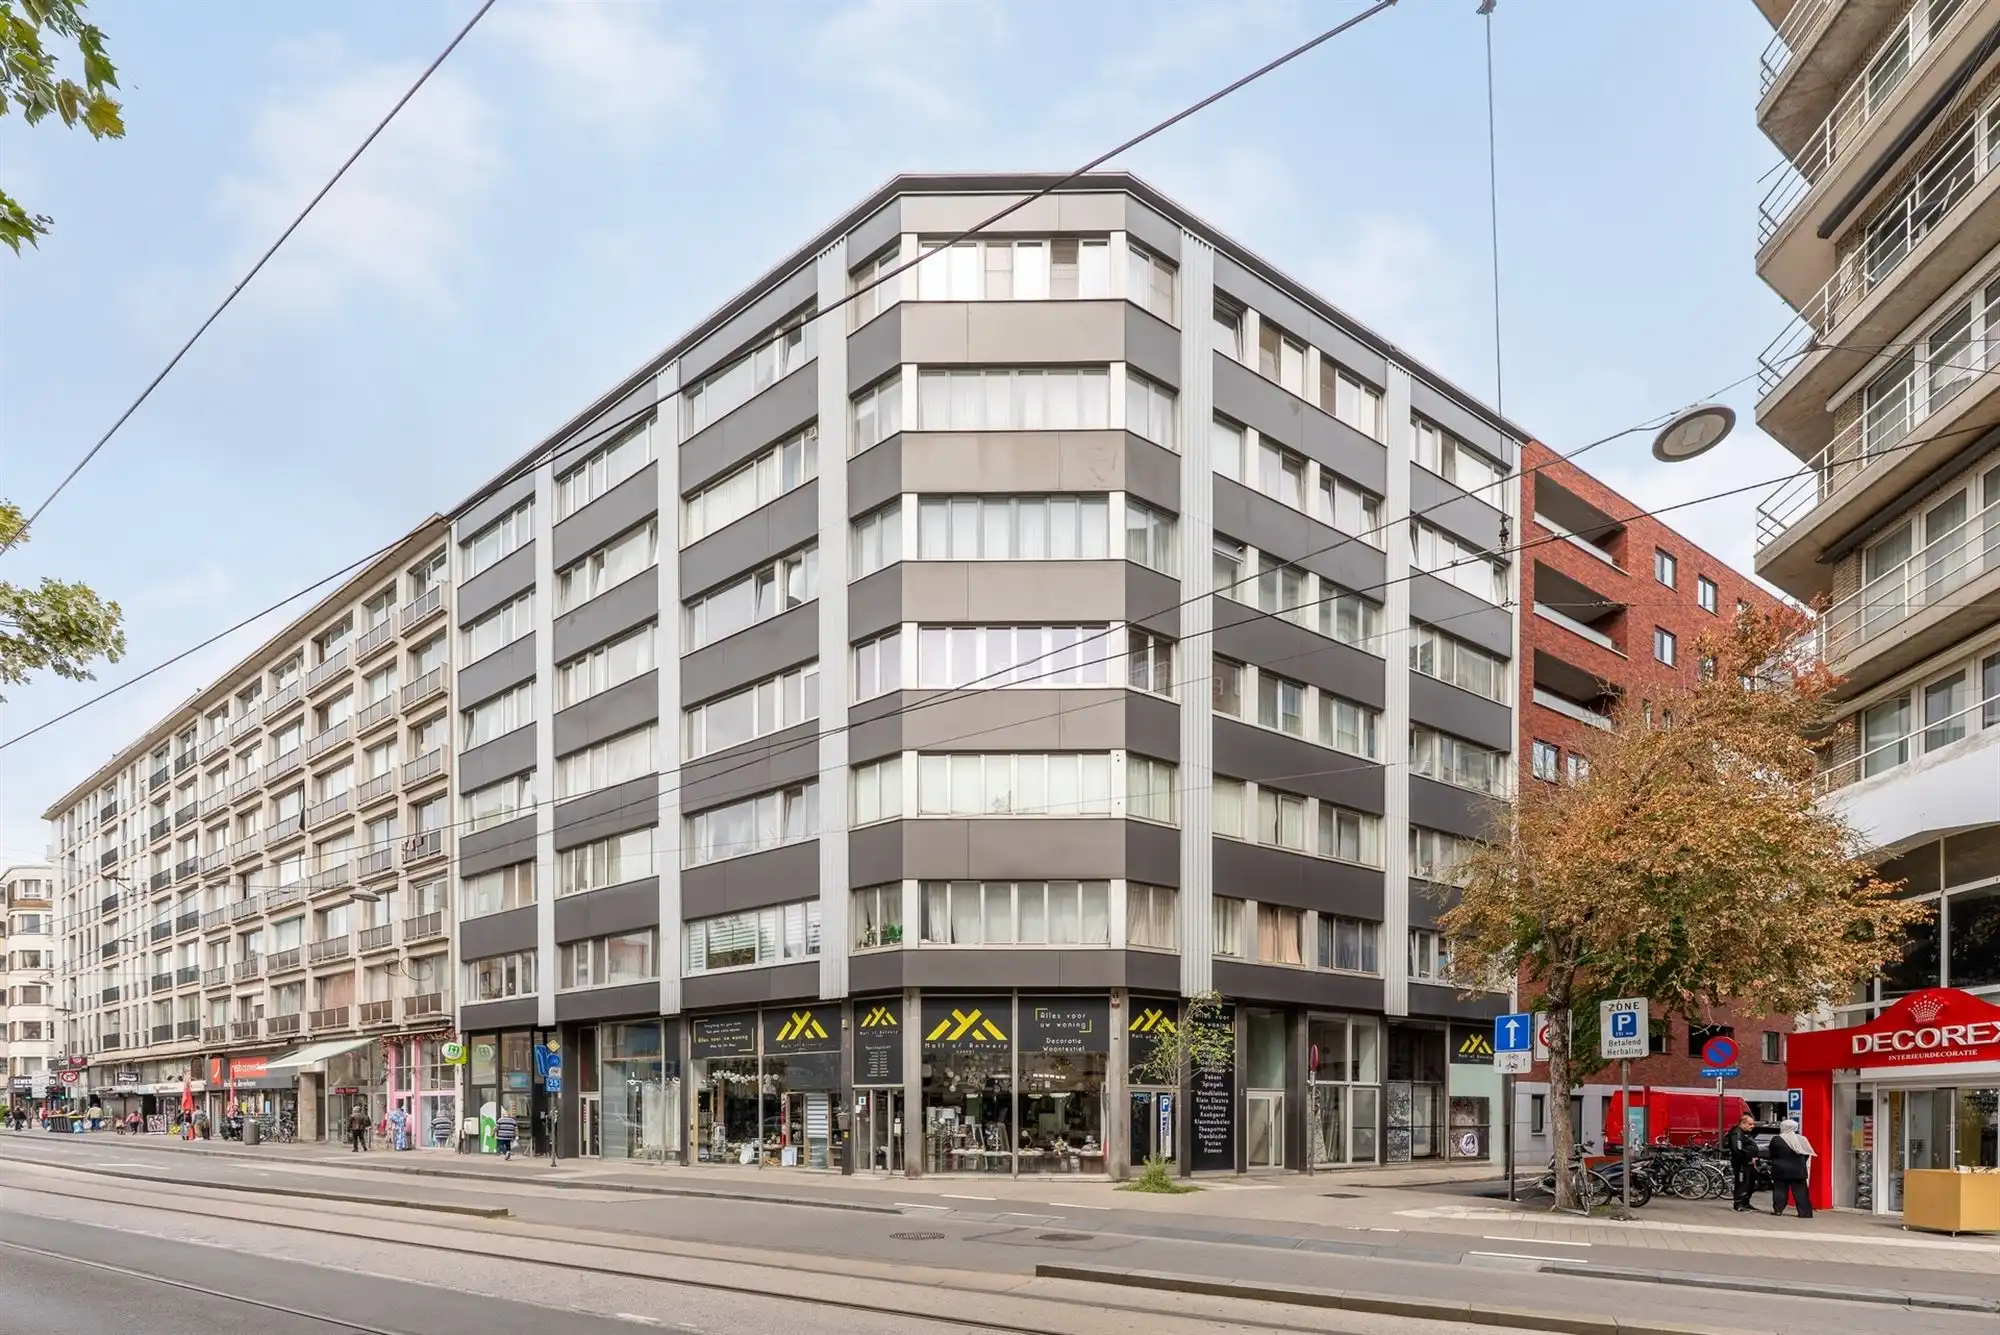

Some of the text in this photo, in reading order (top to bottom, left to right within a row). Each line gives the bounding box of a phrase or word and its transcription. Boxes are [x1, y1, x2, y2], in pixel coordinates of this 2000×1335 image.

[1608, 1001, 1640, 1011] ZONE
[1040, 1011, 1061, 1019] Alles
[1617, 1014, 1631, 1031] P
[969, 1042, 1008, 1050] Antwerp
[1608, 1038, 1641, 1047] Betalend
[1607, 1048, 1643, 1056] Herhaling
[1888, 1049, 1978, 1061] INTERIEURDECORATIE
[1199, 1104, 1227, 1112] Verlichting
